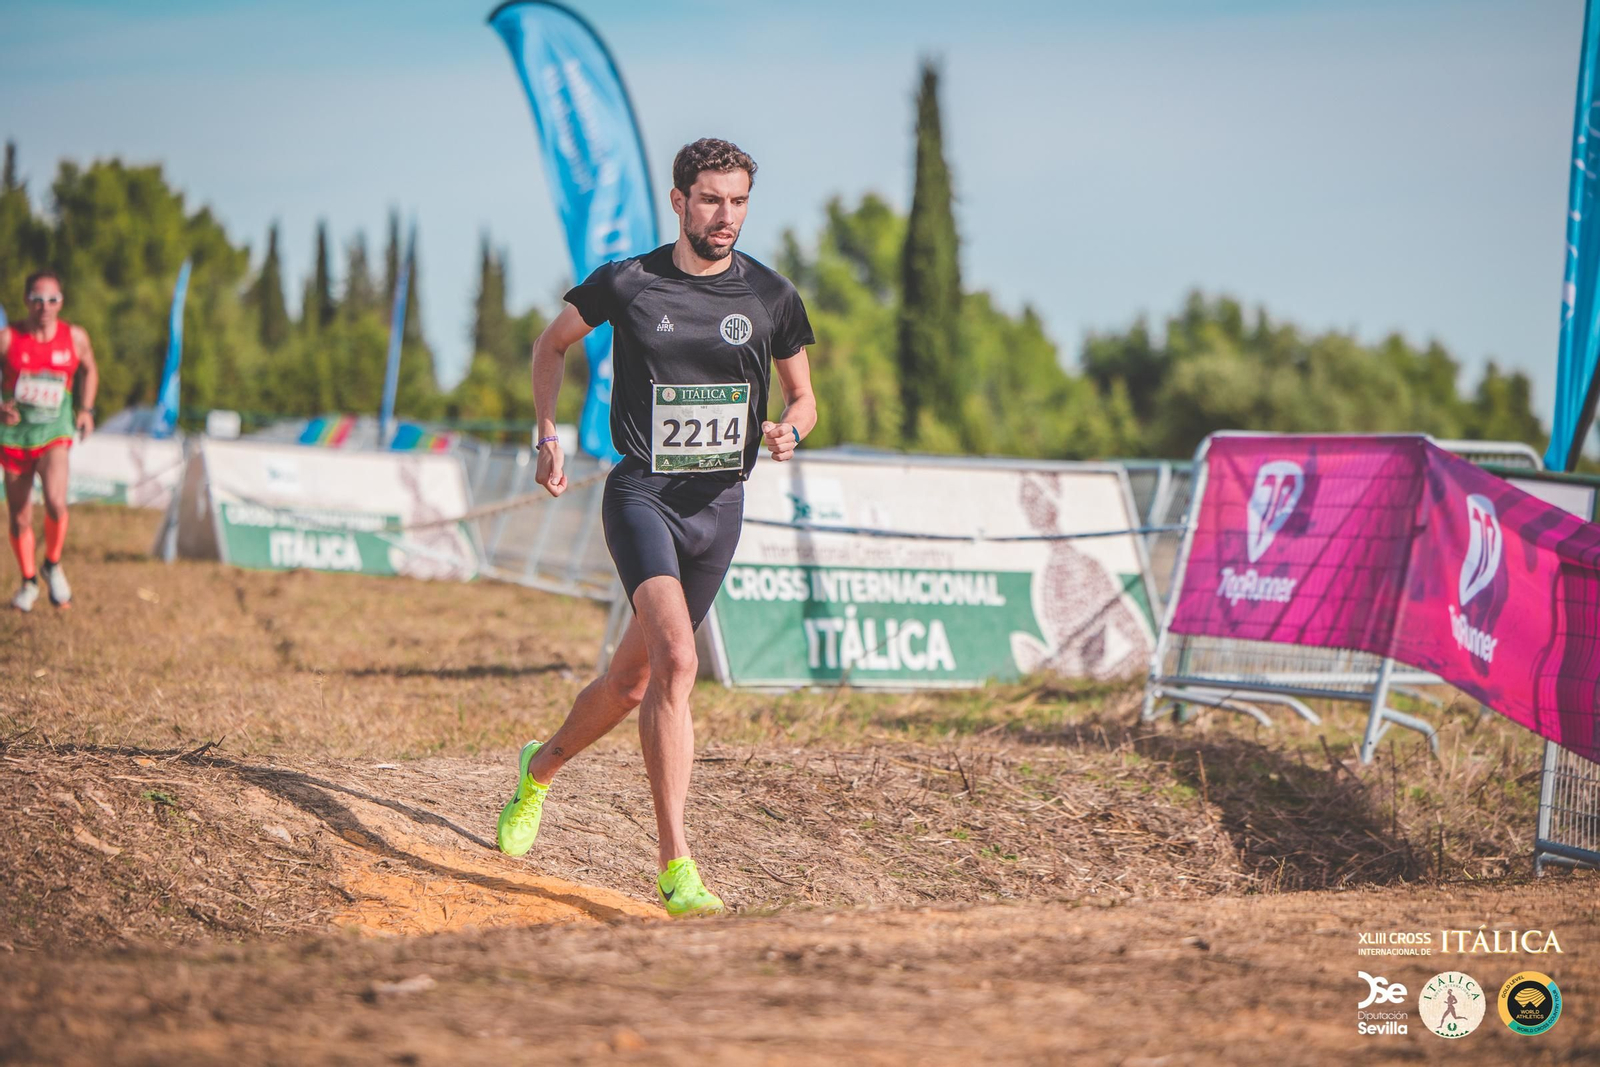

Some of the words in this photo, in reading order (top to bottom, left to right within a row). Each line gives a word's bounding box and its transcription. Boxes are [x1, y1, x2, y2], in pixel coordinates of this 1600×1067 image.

[682, 388, 726, 399] ITÁLICA
[663, 418, 740, 447] 2214
[725, 566, 809, 602] CROSS
[812, 568, 1006, 606] INTERNACIONAL
[805, 605, 956, 672] ITÁLICA
